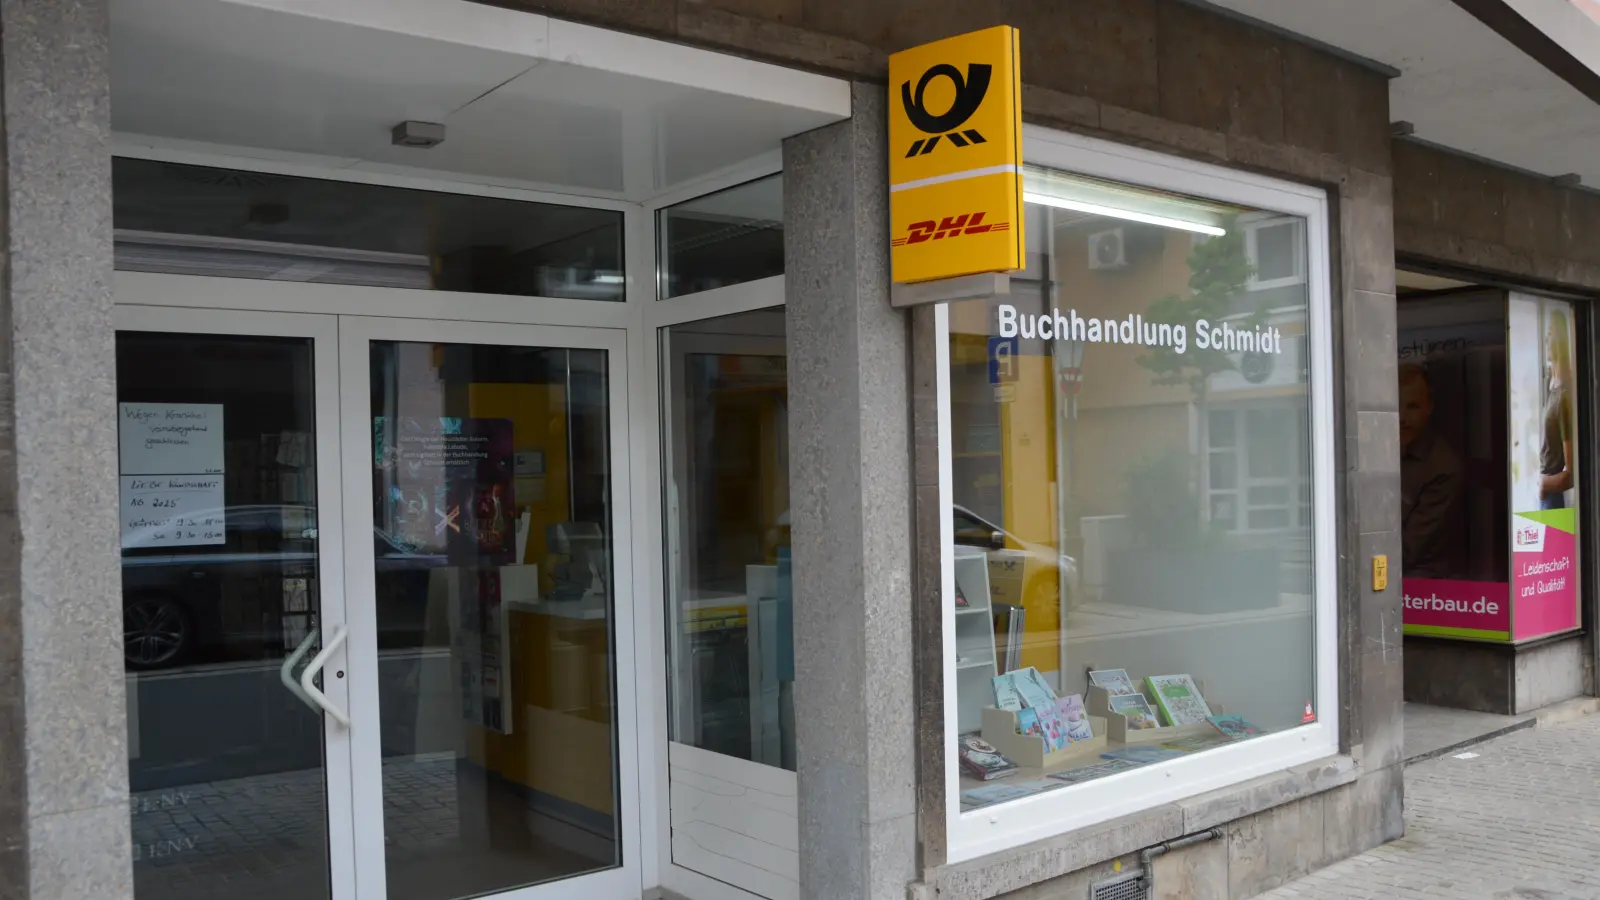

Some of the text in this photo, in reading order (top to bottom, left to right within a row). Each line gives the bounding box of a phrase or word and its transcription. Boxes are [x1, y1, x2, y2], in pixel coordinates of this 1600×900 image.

[906, 212, 993, 245] DHL
[998, 304, 1281, 354] Buchhandlung Schmidt
[1521, 581, 1535, 597] und
